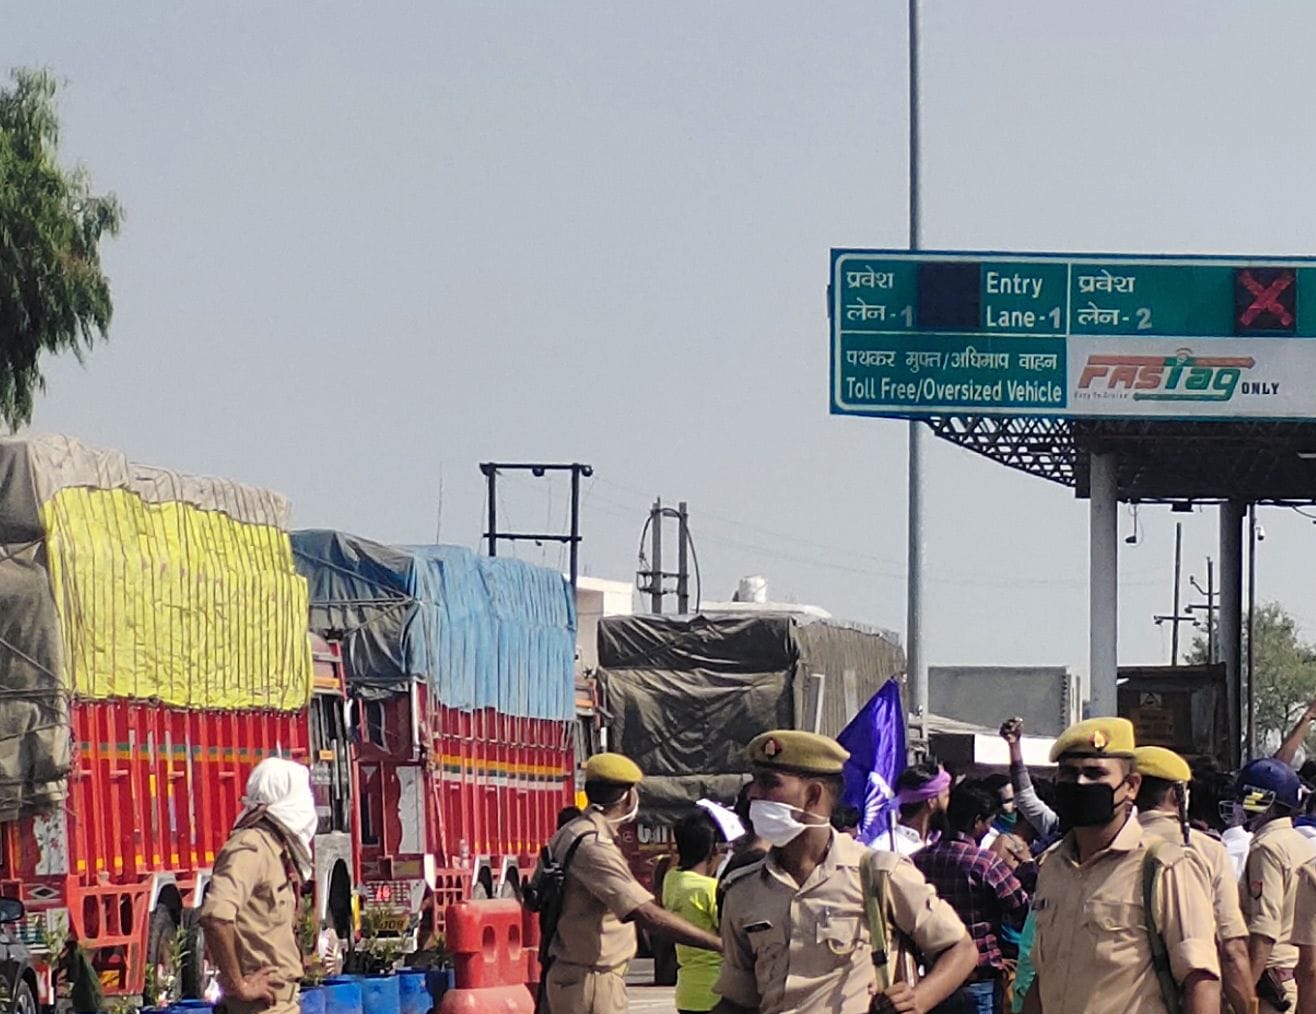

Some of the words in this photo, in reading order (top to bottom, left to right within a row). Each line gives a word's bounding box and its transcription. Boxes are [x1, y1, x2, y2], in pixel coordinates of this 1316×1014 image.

[846, 265, 894, 288] प्रवेश
[987, 272, 1042, 298] Entry
[1078, 269, 1136, 294] प्रवेश
[846, 297, 886, 320] लेन
[1078, 301, 1120, 326] लेन
[847, 350, 896, 366] पथकर
[846, 377, 876, 398] Toll
[1007, 379, 1062, 402] Vehicle
[1241, 382, 1280, 396] ONLY
